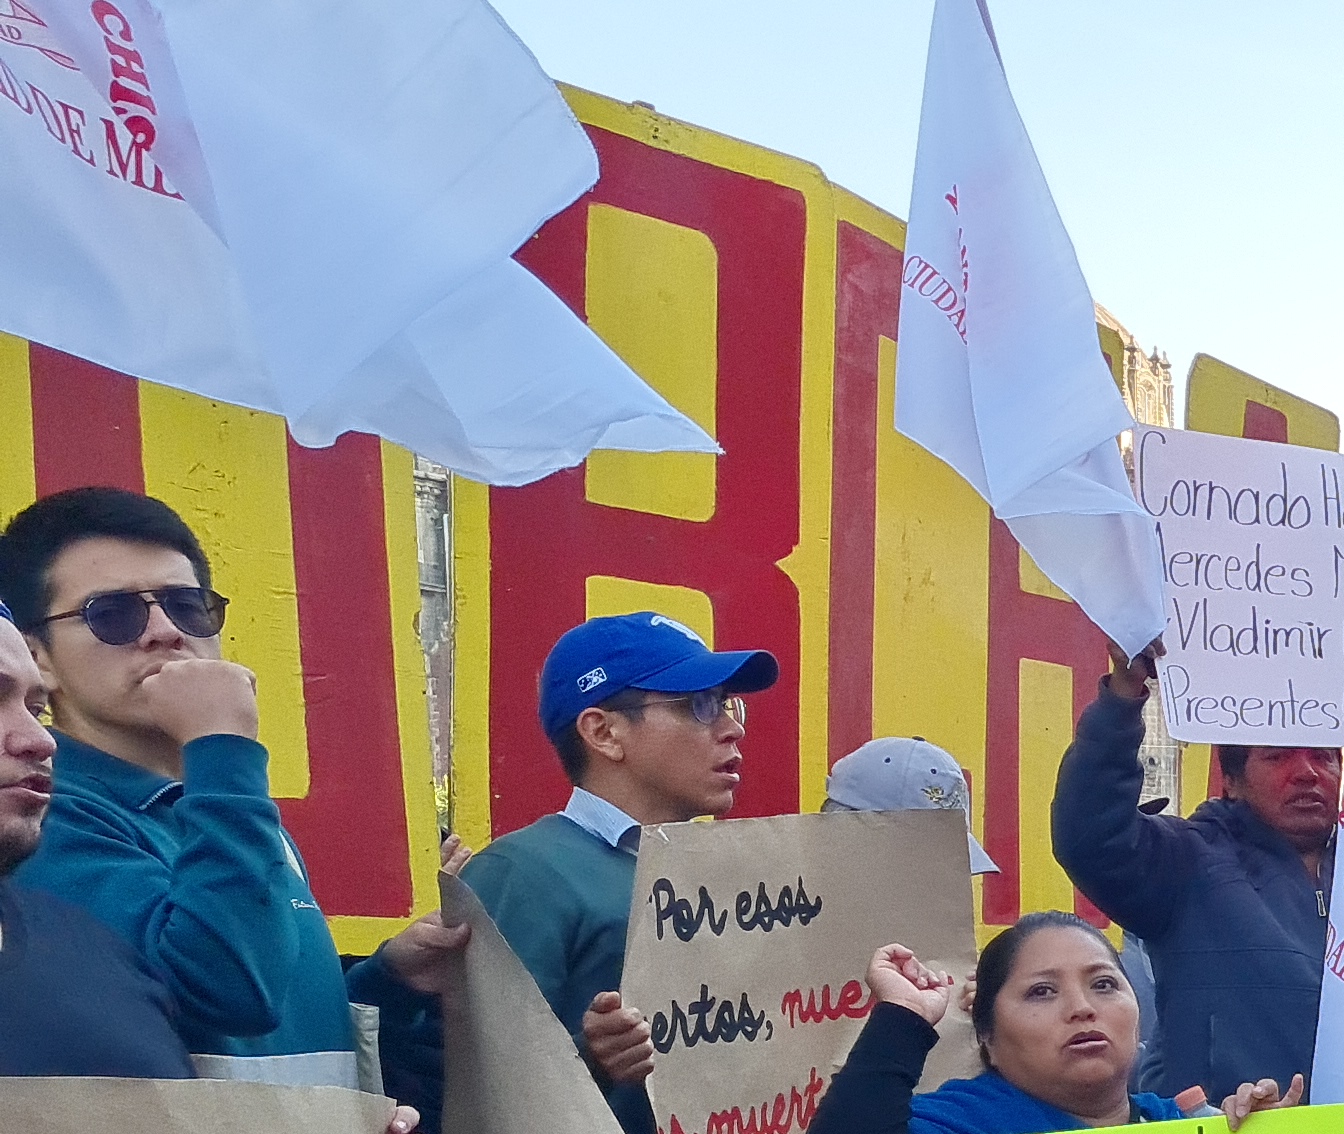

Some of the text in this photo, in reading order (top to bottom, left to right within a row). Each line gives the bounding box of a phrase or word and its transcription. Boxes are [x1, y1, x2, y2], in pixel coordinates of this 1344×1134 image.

[902, 255, 968, 346] CIUDA
[1140, 430, 1311, 530] Cornado
[1173, 598, 1332, 659] Vladimir
[651, 984, 773, 1054] ertos,
